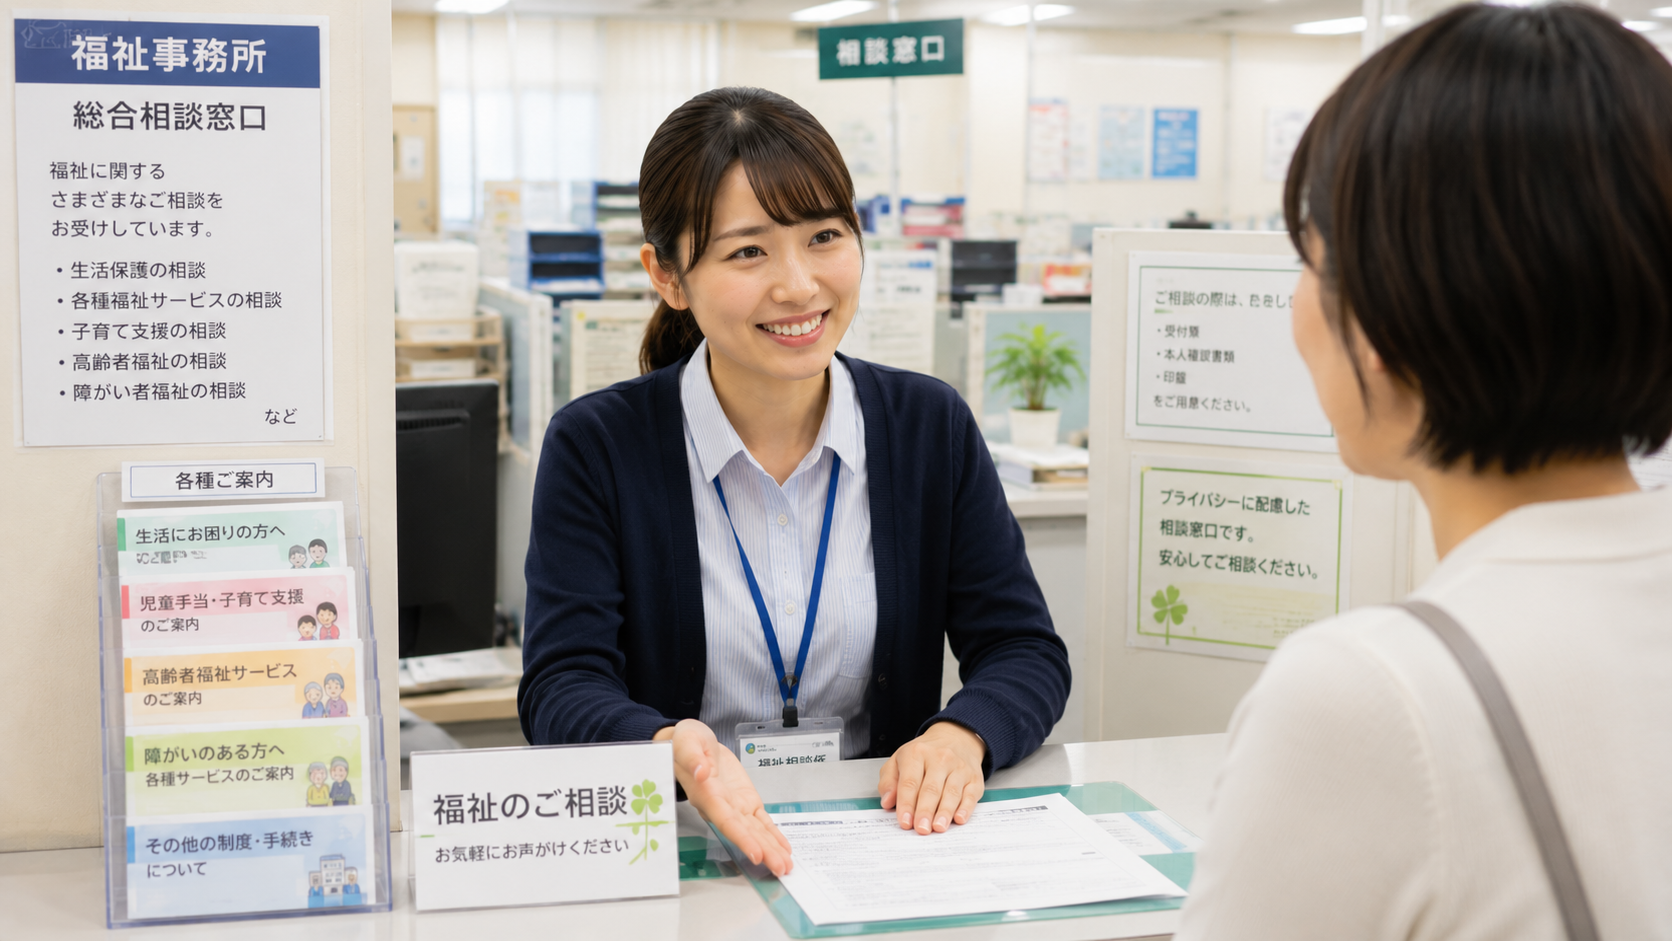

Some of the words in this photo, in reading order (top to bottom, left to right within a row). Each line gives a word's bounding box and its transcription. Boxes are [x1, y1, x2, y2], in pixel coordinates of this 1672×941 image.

[71, 34, 266, 73] 福祉事務所
[836, 35, 945, 66] 相談窓口
[73, 101, 265, 131] 総合相談窓口
[50, 162, 164, 180] 福祉に関する
[52, 191, 222, 209] さまざまなご相談を
[52, 219, 211, 237] お受けしています。
[265, 408, 297, 425] など
[175, 470, 275, 490] 各種ご案内
[1161, 489, 1310, 515] プライバシーに配慮した
[136, 524, 286, 544] 生活にお困りの方へ
[1160, 519, 1253, 542] 相談窓口です。
[1159, 549, 1317, 579] 安心してご相談ください。
[141, 588, 304, 611] 児童手当・子育て支援
[141, 617, 199, 632] のご案内
[143, 663, 297, 686] 高齢者福祉サービス
[144, 691, 201, 706] のご案内
[145, 743, 286, 766] 障がいのある方へ
[145, 766, 295, 787] 各種サービスのご案内
[434, 785, 628, 826] 福祉のご相談
[146, 830, 313, 854] その他の制度・手続き
[434, 840, 629, 863] お気軽にお声がけください
[147, 862, 207, 878] について
